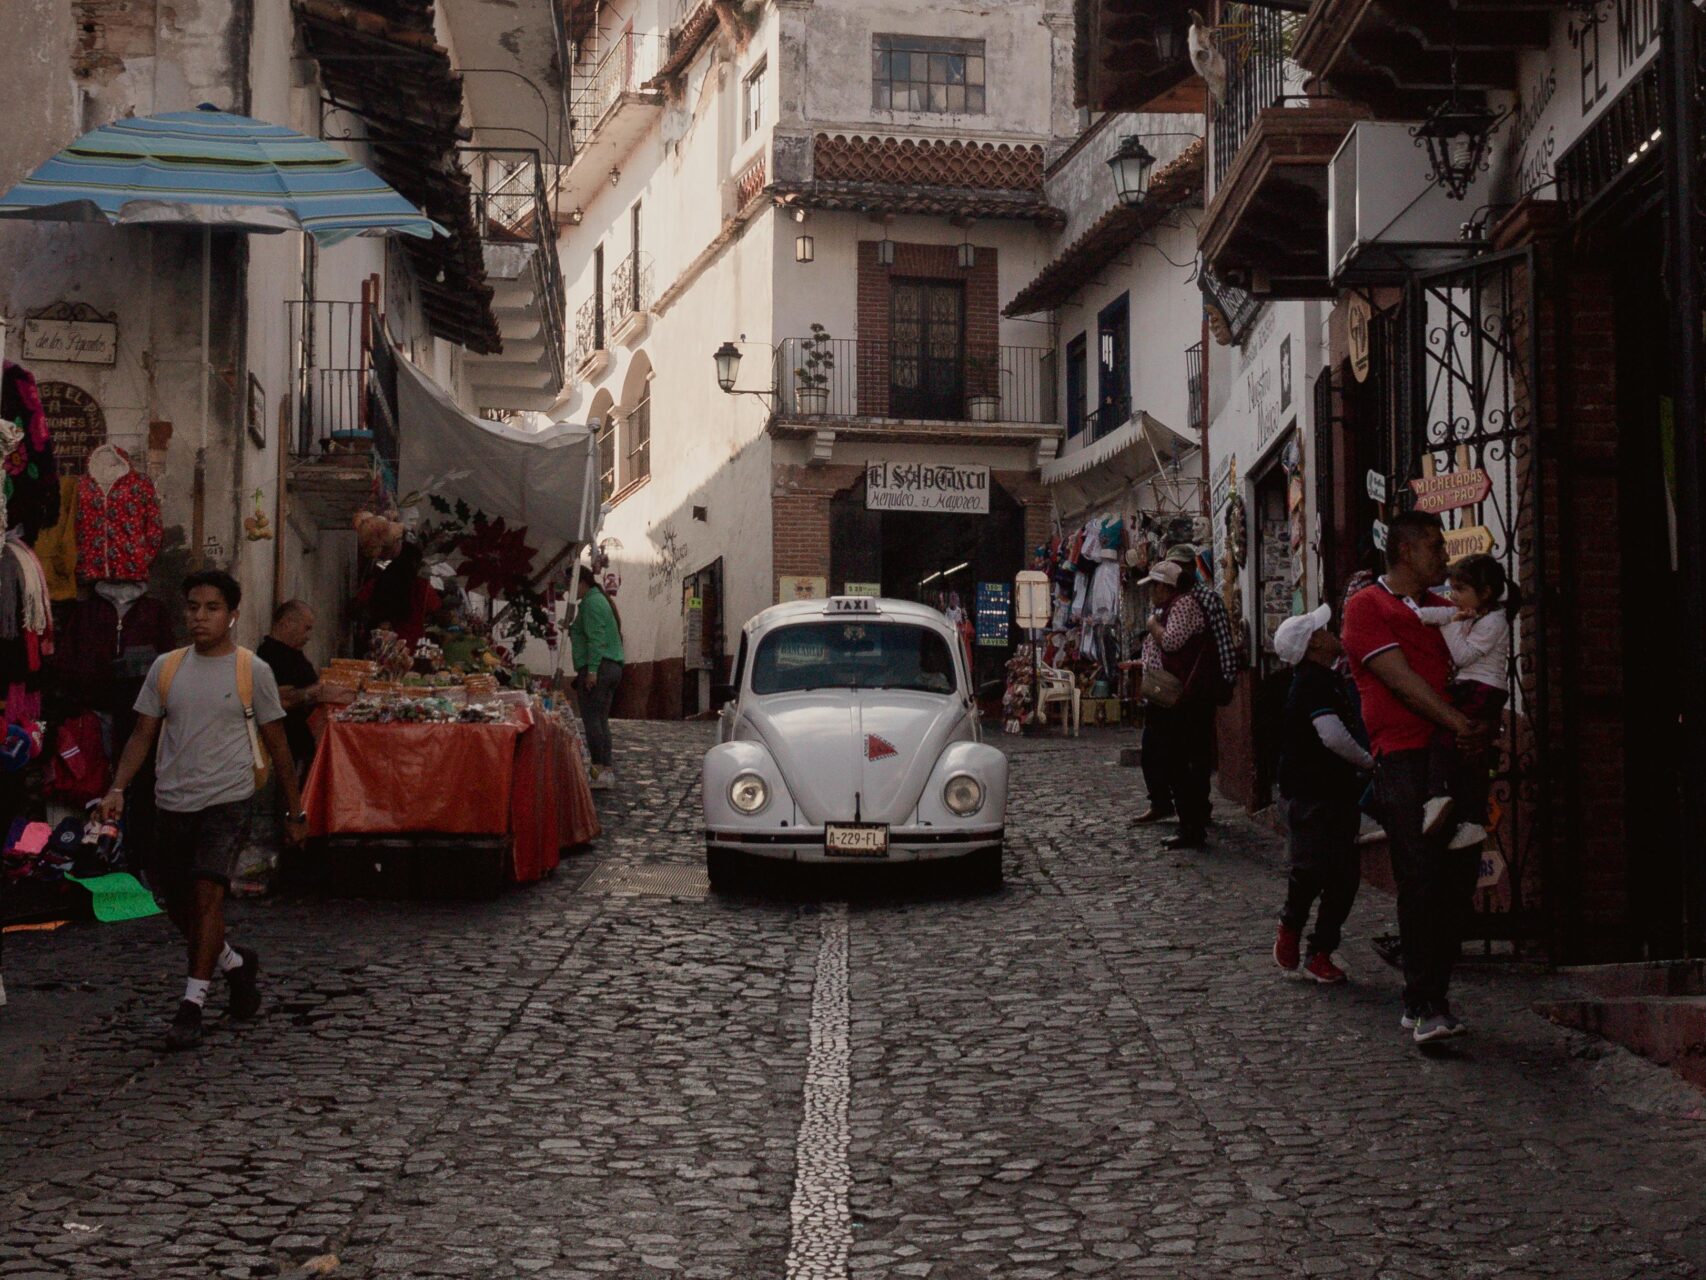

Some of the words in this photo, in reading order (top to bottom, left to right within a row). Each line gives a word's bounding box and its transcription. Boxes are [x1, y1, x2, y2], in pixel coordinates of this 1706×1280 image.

[866, 462, 887, 489] El
[1415, 471, 1483, 494] MICHELADAS
[869, 490, 915, 508] Menudeo
[932, 493, 981, 512] Mayoreo
[1421, 495, 1445, 510] DON
[836, 600, 869, 610] TAXI
